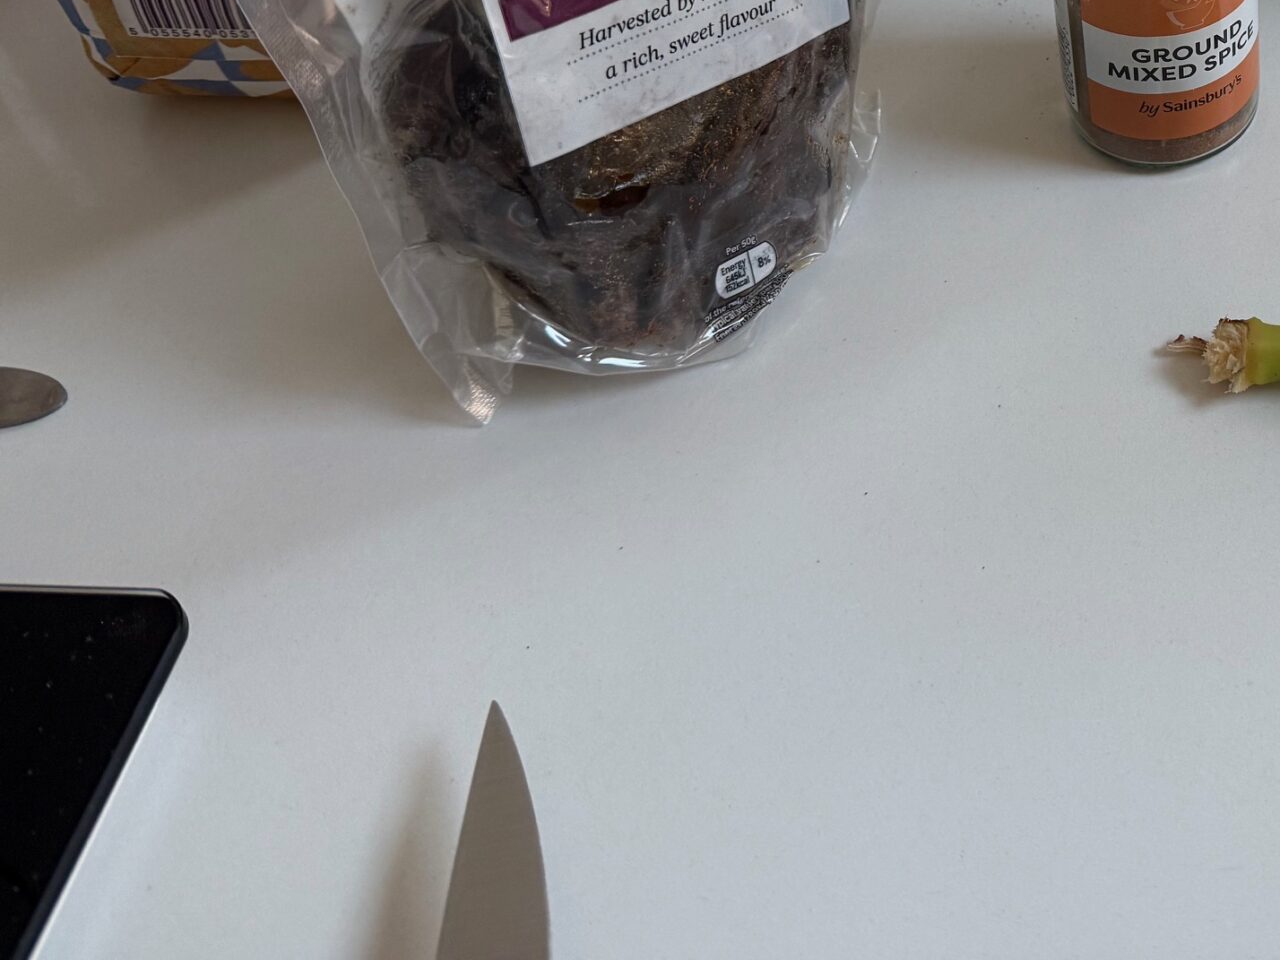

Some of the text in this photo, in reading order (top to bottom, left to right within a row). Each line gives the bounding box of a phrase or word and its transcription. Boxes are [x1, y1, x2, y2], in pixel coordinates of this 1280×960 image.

[605, 62, 617, 80] a
[623, 45, 665, 75] rich,
[669, 21, 715, 55] sweet
[1108, 62, 1197, 82] MIXED
[1204, 19, 1254, 72] SPICE
[1131, 19, 1243, 63] GROUND
[1139, 74, 1243, 118] by Sainsbury's
[721, 258, 746, 276] Energy
